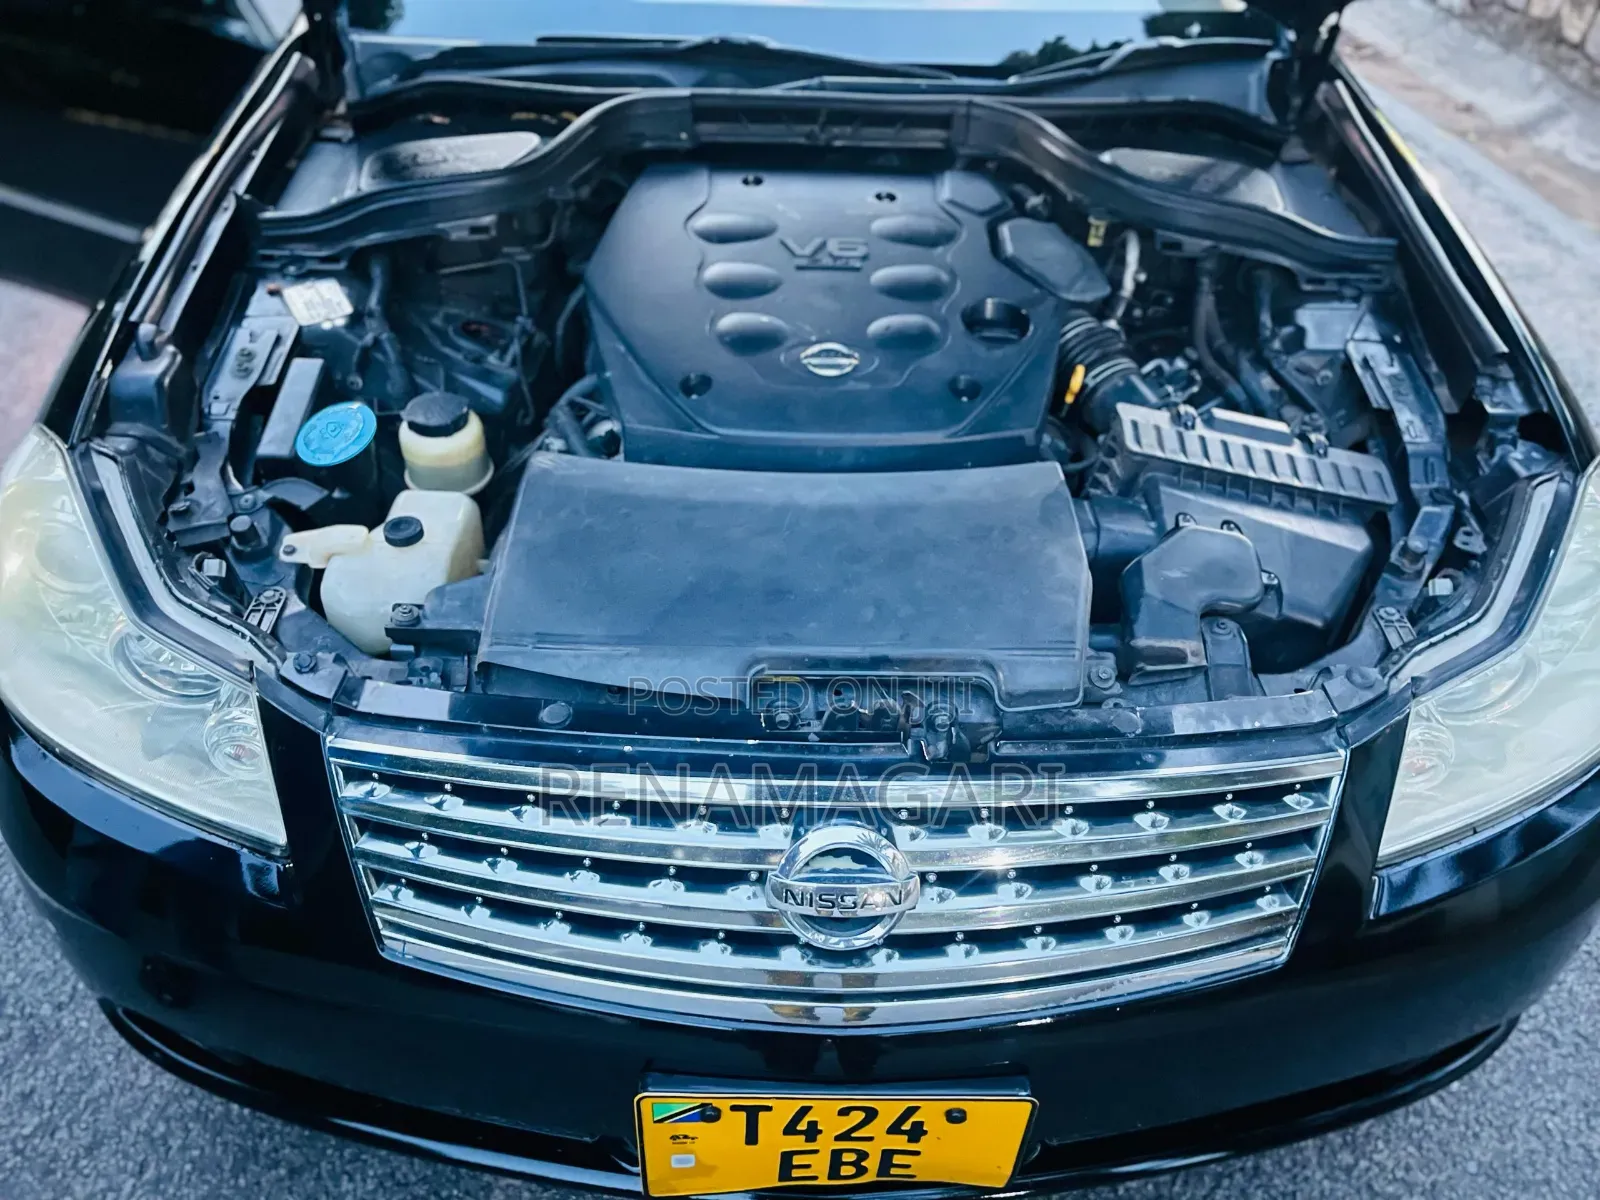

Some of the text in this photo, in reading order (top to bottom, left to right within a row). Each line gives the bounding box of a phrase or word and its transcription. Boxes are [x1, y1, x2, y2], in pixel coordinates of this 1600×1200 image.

[779, 237, 869, 260] V6
[783, 888, 903, 910] NISSAN
[777, 1148, 922, 1183] EBE
